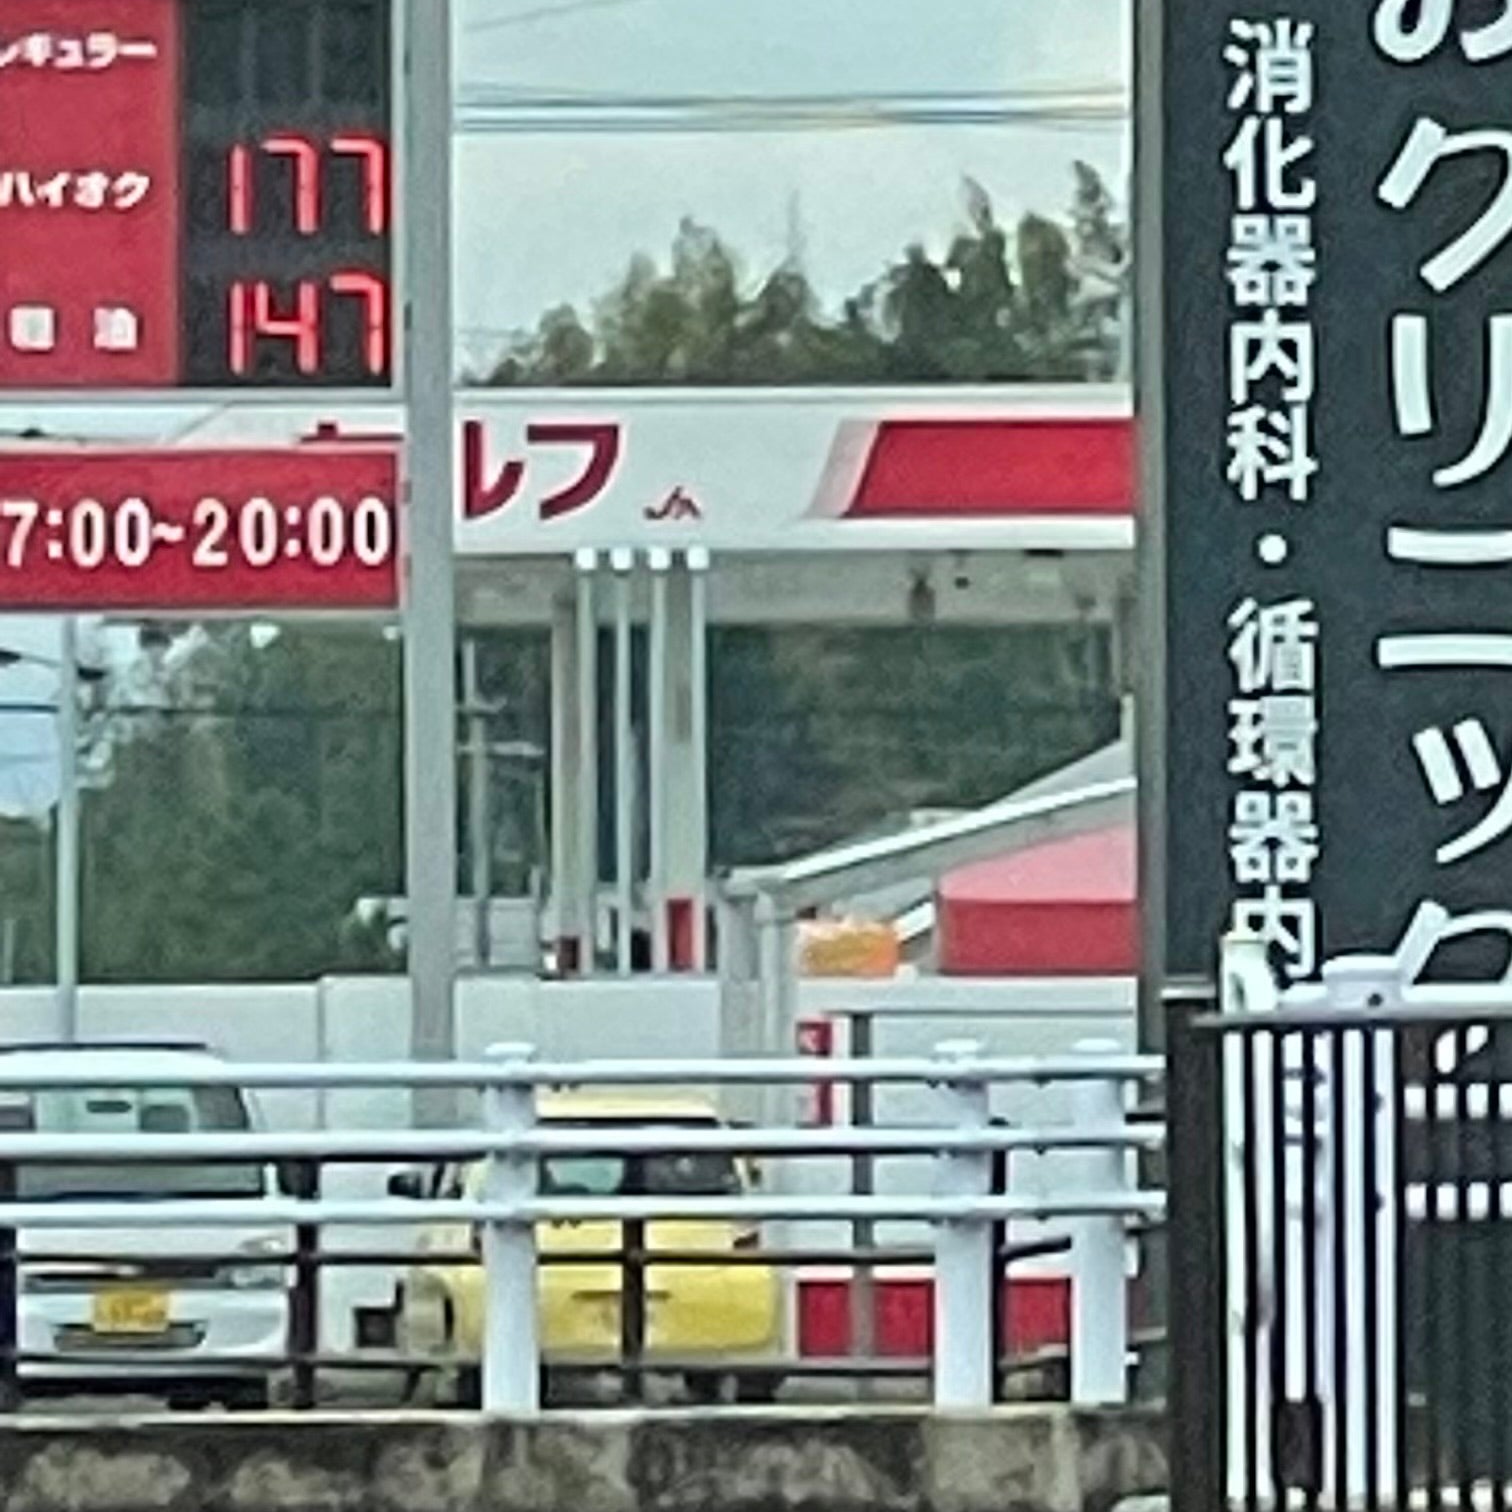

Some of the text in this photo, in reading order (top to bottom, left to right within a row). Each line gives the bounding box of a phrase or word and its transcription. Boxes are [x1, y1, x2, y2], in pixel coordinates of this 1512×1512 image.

[0, 172, 150, 208] ハイオク
[230, 138, 384, 234] 177
[230, 275, 384, 374] 147
